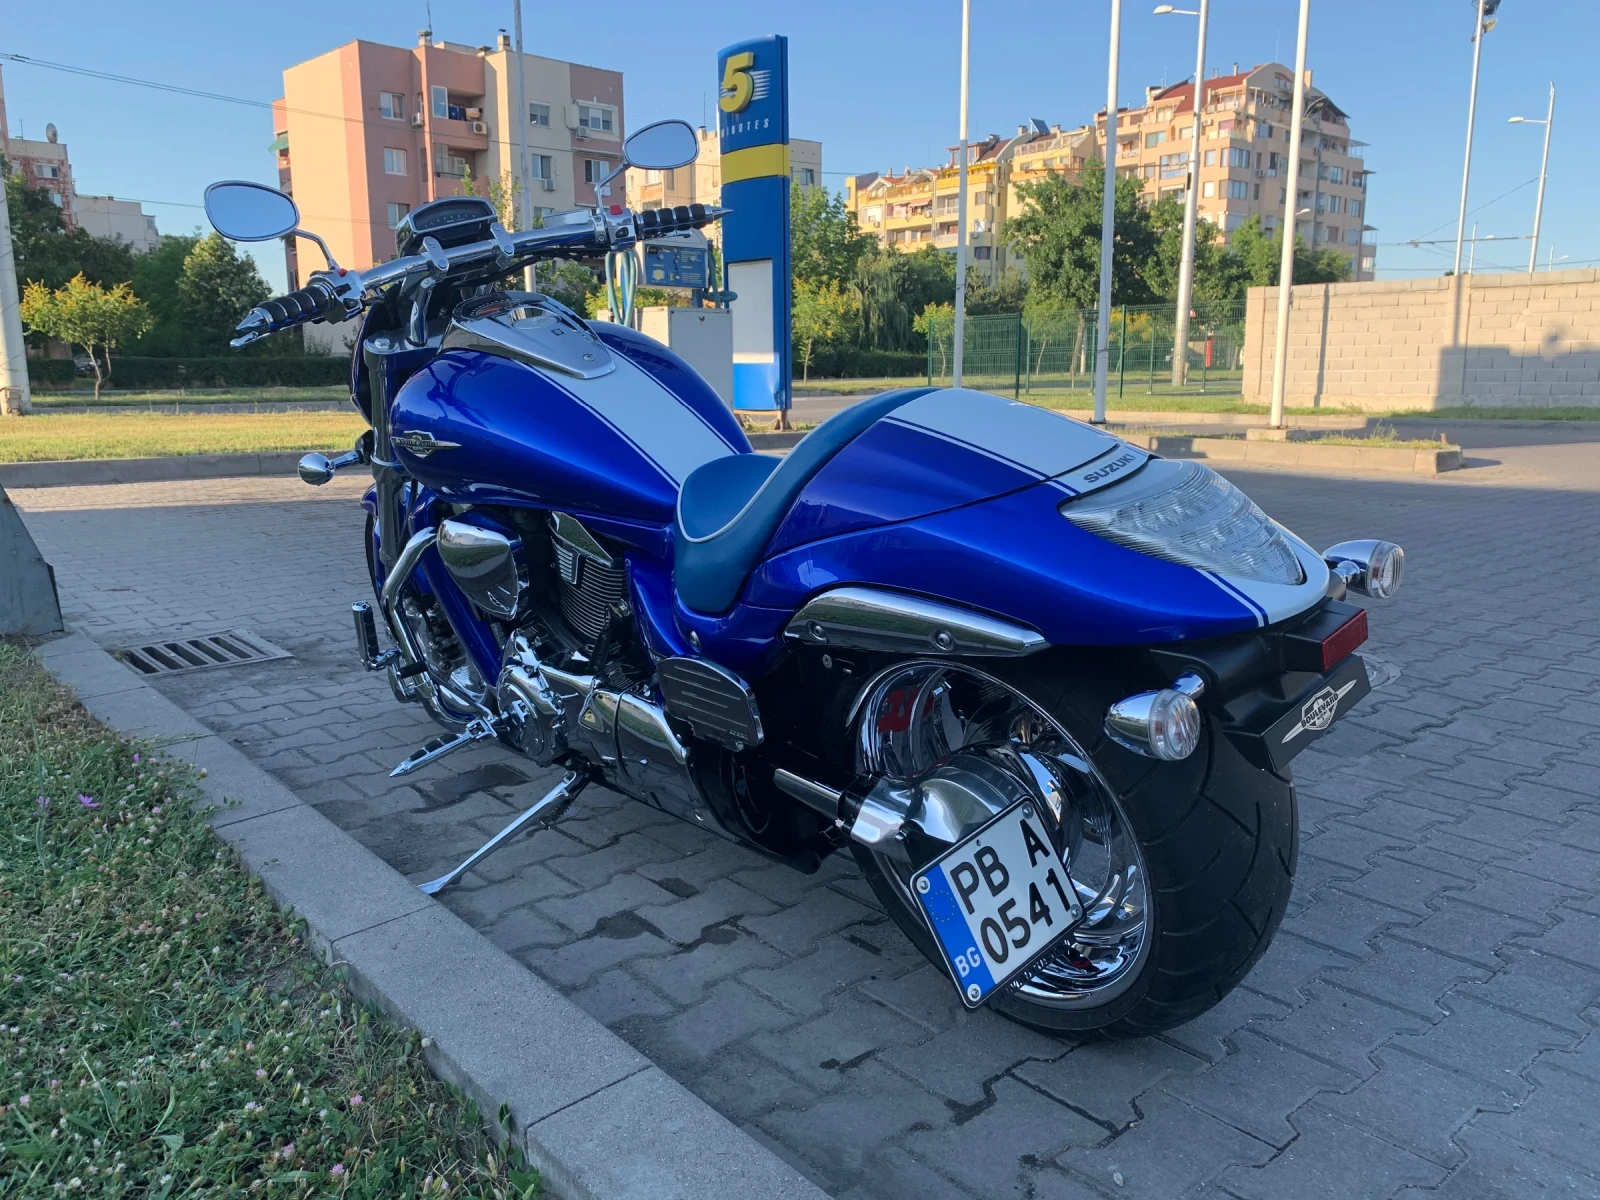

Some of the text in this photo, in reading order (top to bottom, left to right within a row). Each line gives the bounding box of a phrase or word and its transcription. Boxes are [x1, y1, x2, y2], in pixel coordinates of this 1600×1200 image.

[719, 52, 754, 113] 5
[1083, 453, 1136, 483] SUZUKI
[1301, 693, 1338, 728] BOULEVARD
[949, 818, 1050, 915] PB A
[980, 868, 1071, 964] 0541
[954, 946, 981, 978] BG
